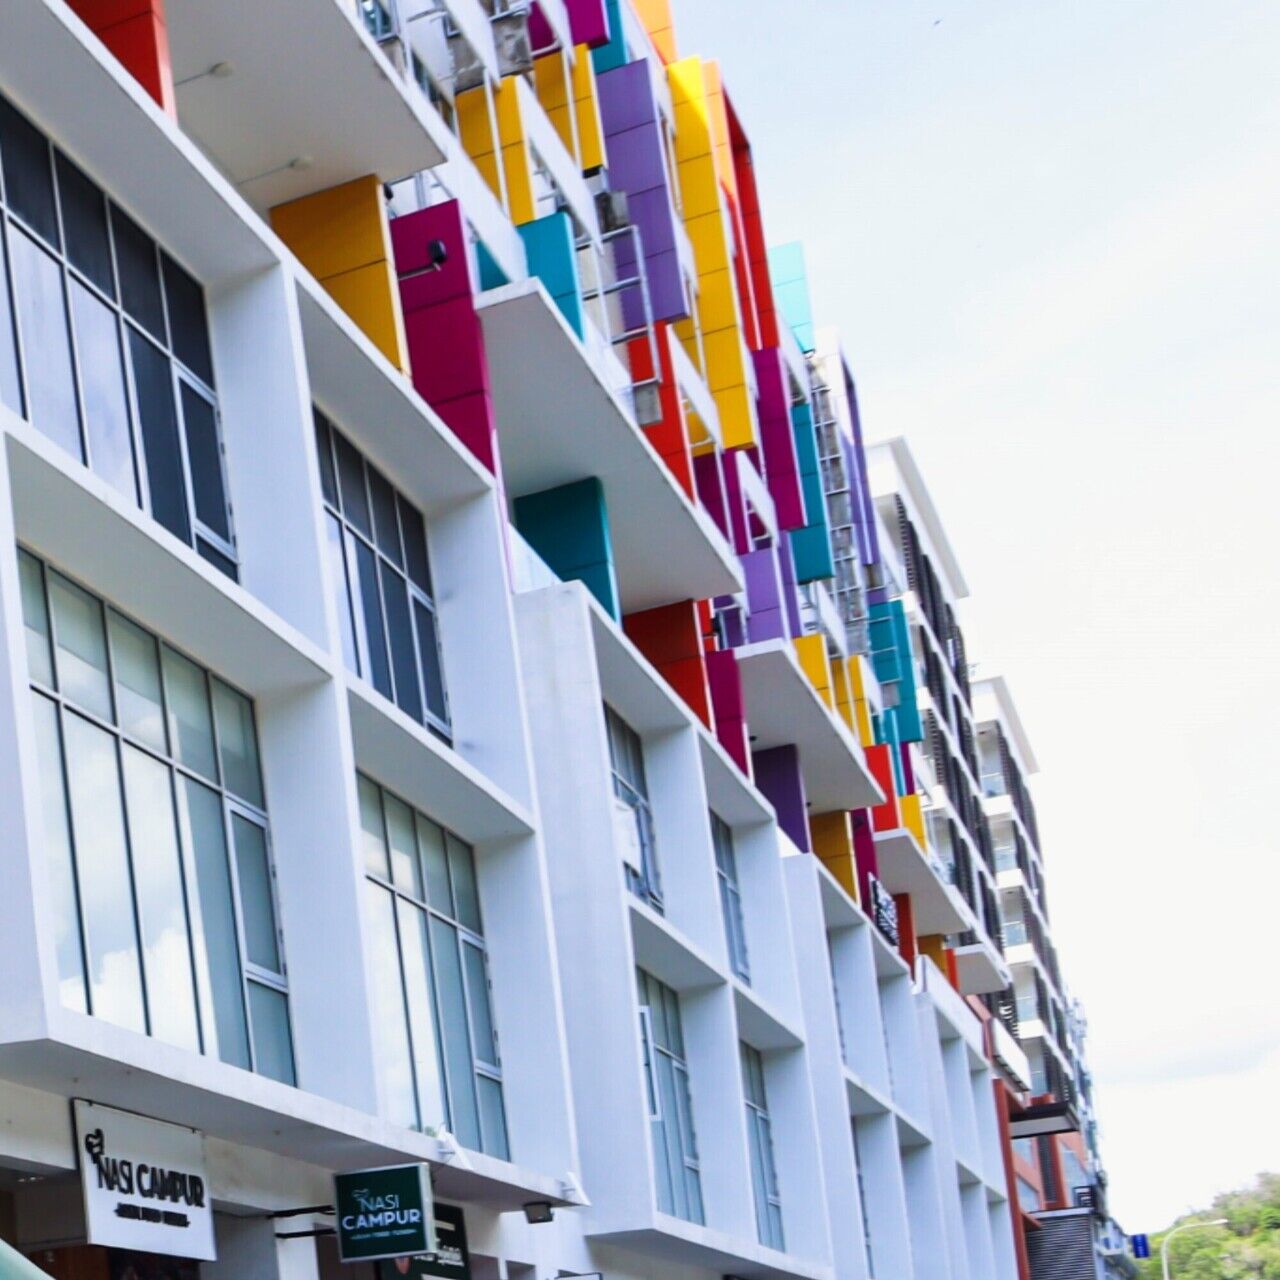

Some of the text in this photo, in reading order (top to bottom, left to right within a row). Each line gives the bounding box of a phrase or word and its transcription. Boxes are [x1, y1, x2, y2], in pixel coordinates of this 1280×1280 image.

[96, 1157, 205, 1208] NASI CAMPUR
[360, 1194, 400, 1212] NASI
[341, 1208, 422, 1231] CAMPUR
